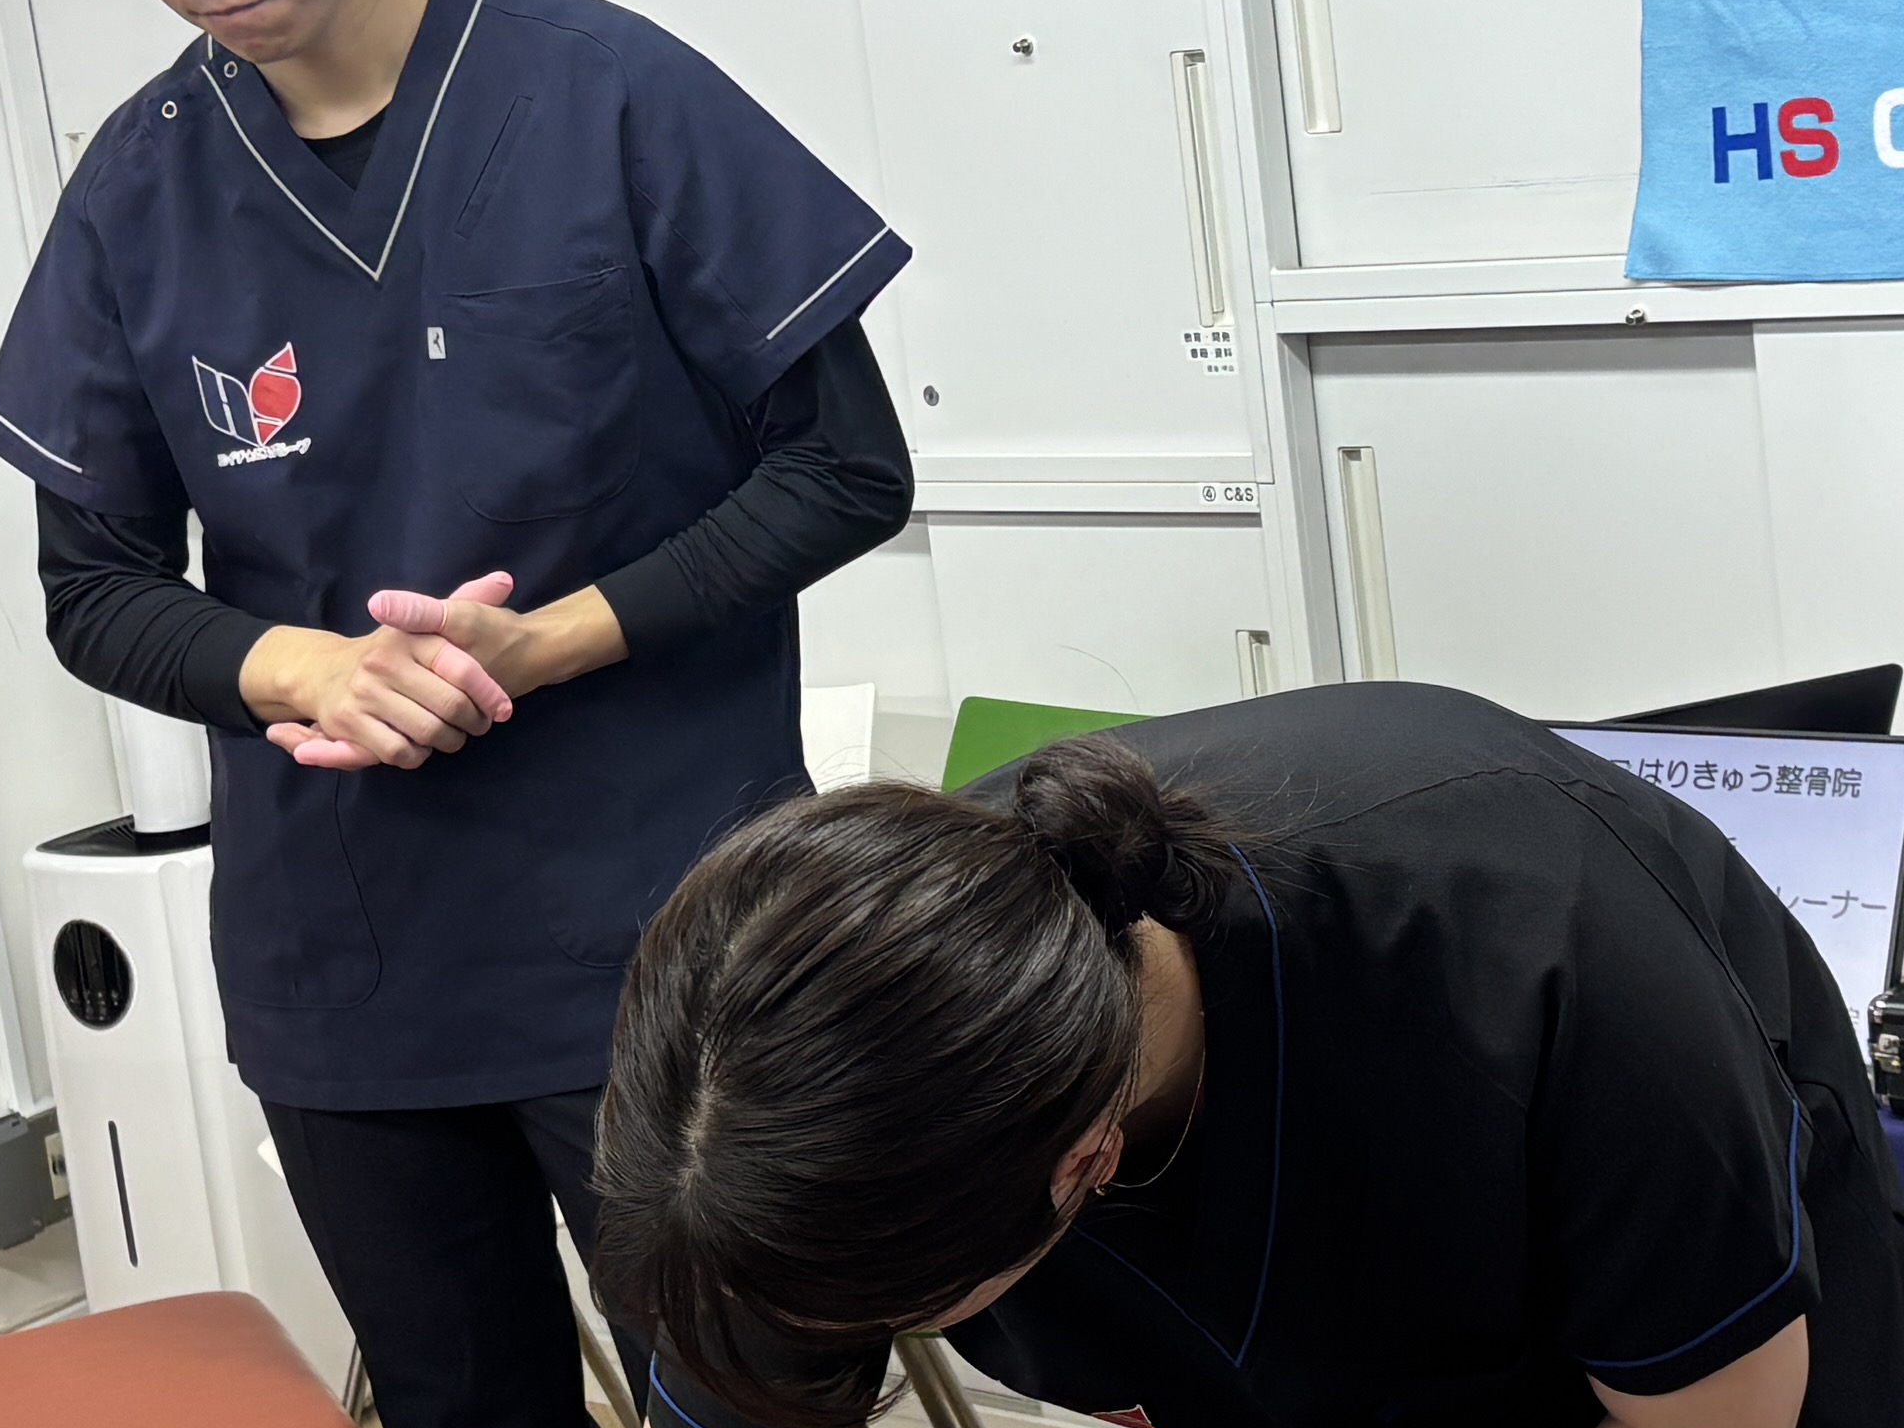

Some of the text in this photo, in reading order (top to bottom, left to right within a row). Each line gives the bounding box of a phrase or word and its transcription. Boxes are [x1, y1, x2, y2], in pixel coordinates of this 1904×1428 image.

[1711, 97, 1839, 184] HS
[1224, 487, 1254, 502] C&S
[1609, 759, 1863, 798] はりきゅう整骨院
